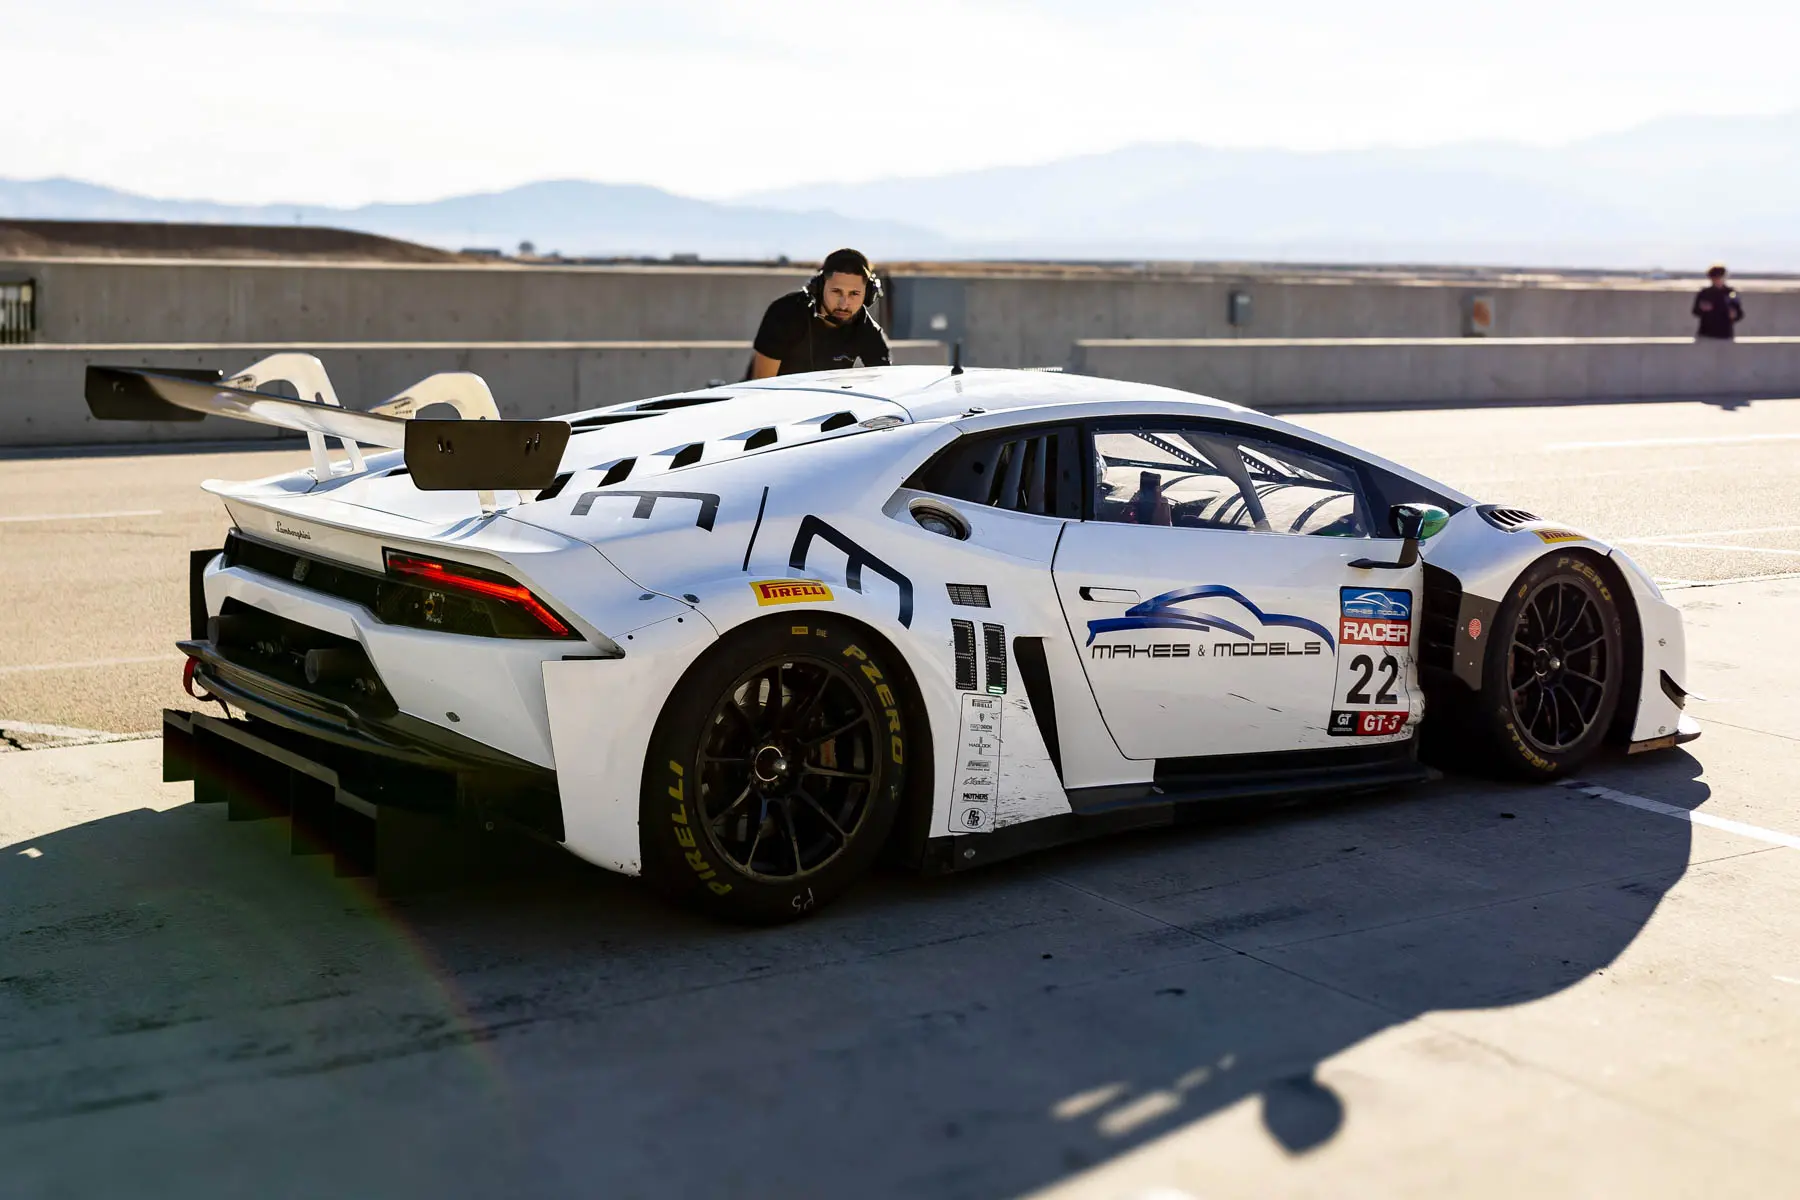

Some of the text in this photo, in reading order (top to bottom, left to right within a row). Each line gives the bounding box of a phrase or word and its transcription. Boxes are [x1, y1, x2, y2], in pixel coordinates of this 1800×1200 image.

[275, 520, 312, 540] Lamborghini
[758, 581, 826, 599] PIRELLI
[1343, 621, 1408, 642] RACER
[1092, 641, 1321, 659] MAKES & MODELS
[1346, 654, 1399, 705] 22
[972, 699, 993, 709] PIRELLI
[1337, 713, 1352, 726] GT
[1363, 714, 1401, 732] GT-3
[963, 792, 989, 800] MOTHERS
[668, 760, 733, 896] PIRELLI
